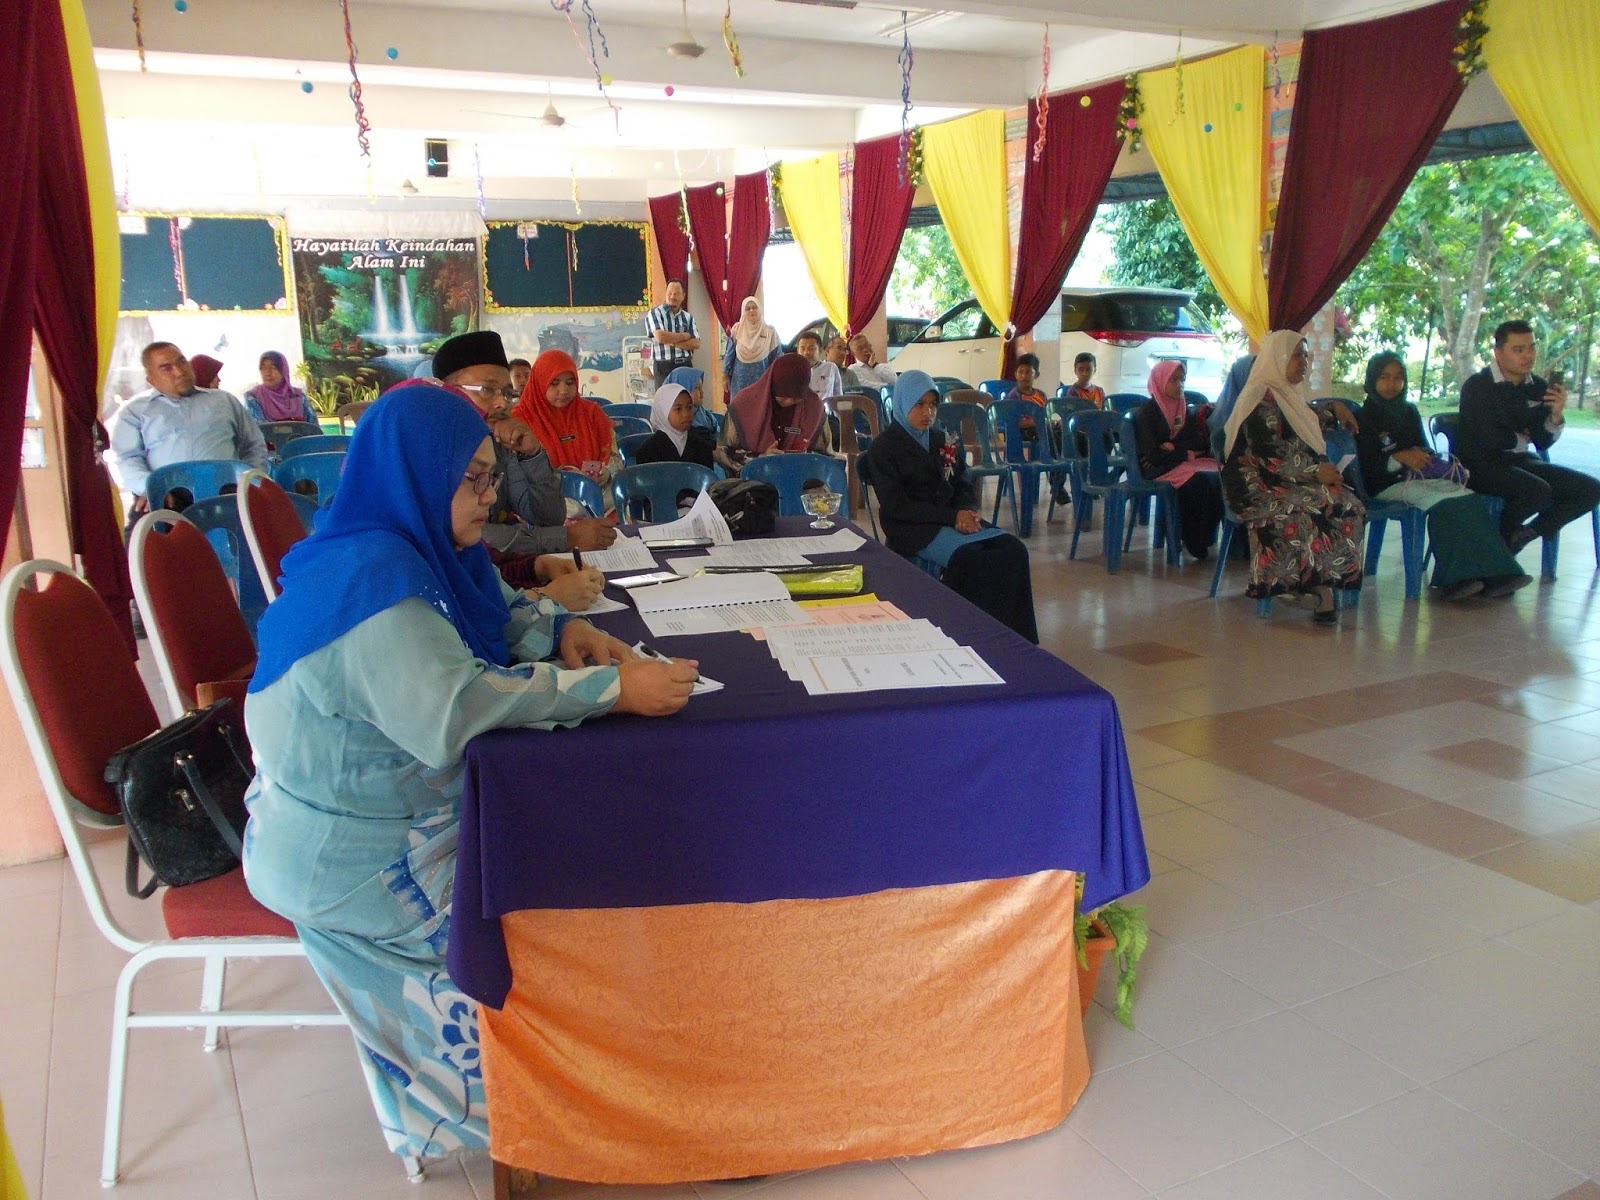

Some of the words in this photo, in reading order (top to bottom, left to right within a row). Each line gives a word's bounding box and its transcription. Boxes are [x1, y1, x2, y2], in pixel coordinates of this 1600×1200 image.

[293, 239, 380, 256] Hayatilah
[385, 239, 475, 254] Keindahan
[347, 254, 394, 270] Alam
[399, 255, 426, 268] Ini
